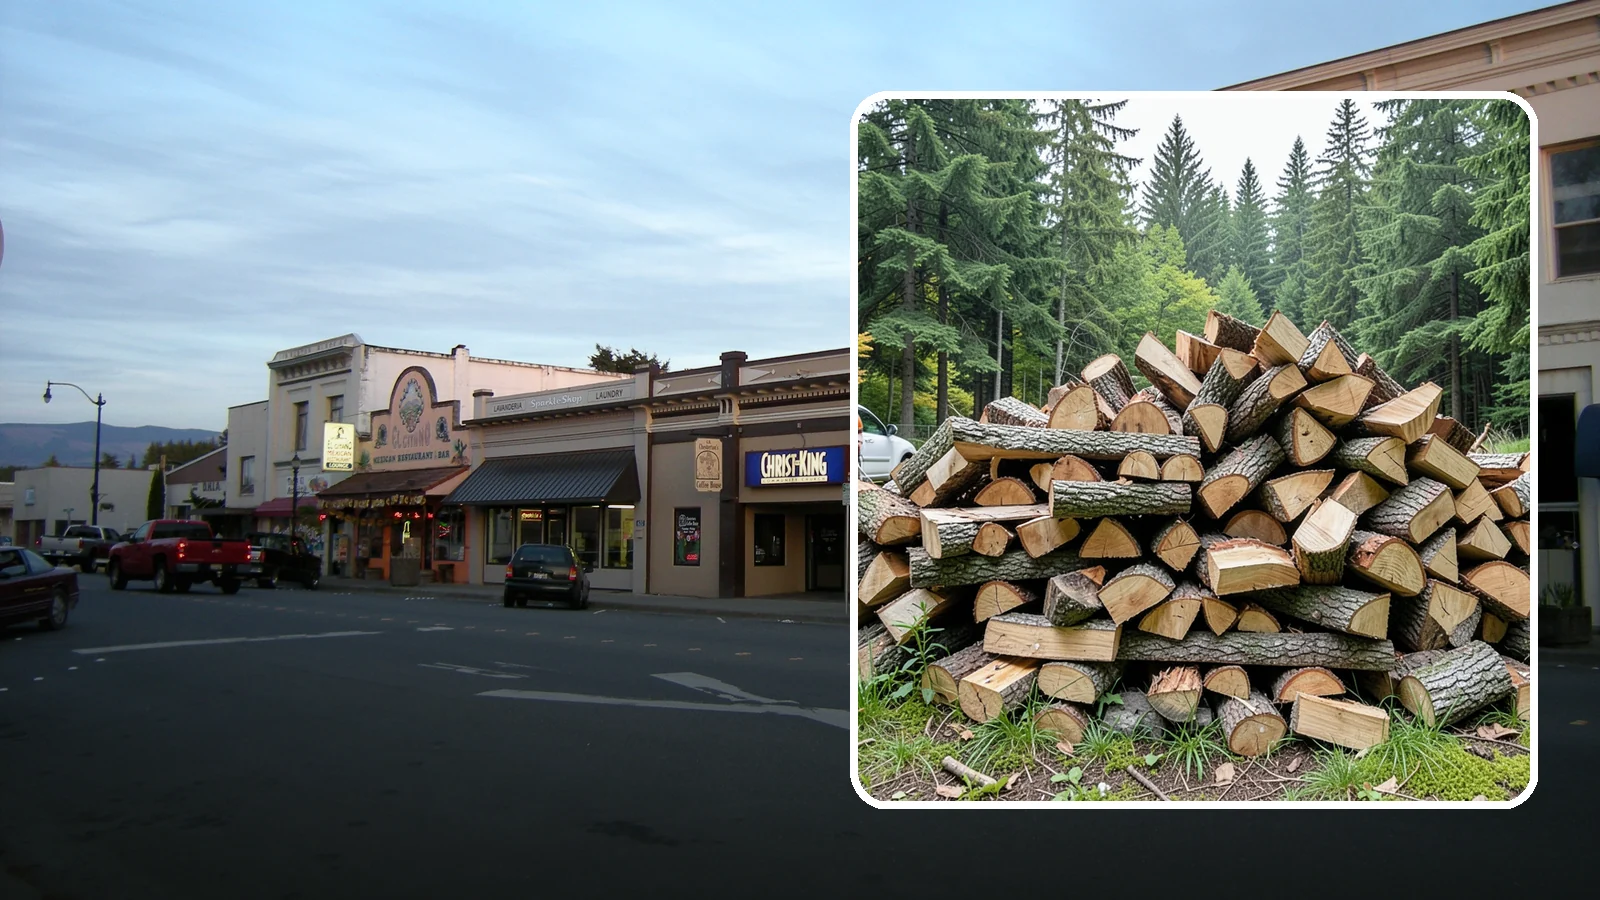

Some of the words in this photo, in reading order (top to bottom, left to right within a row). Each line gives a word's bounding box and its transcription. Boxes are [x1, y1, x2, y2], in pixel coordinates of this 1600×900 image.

[595, 389, 623, 400] LAUNDRY
[493, 402, 523, 413] LAVANDERIA
[530, 396, 562, 409] Sparkle
[561, 395, 582, 406] Shop
[374, 454, 396, 465] MEXICAN
[397, 451, 434, 463] RESTAURANT
[437, 450, 450, 459] BAR
[761, 452, 798, 478] CHRIST
[799, 450, 827, 477] KING
[697, 481, 709, 489] Coffee
[710, 481, 721, 489] House
